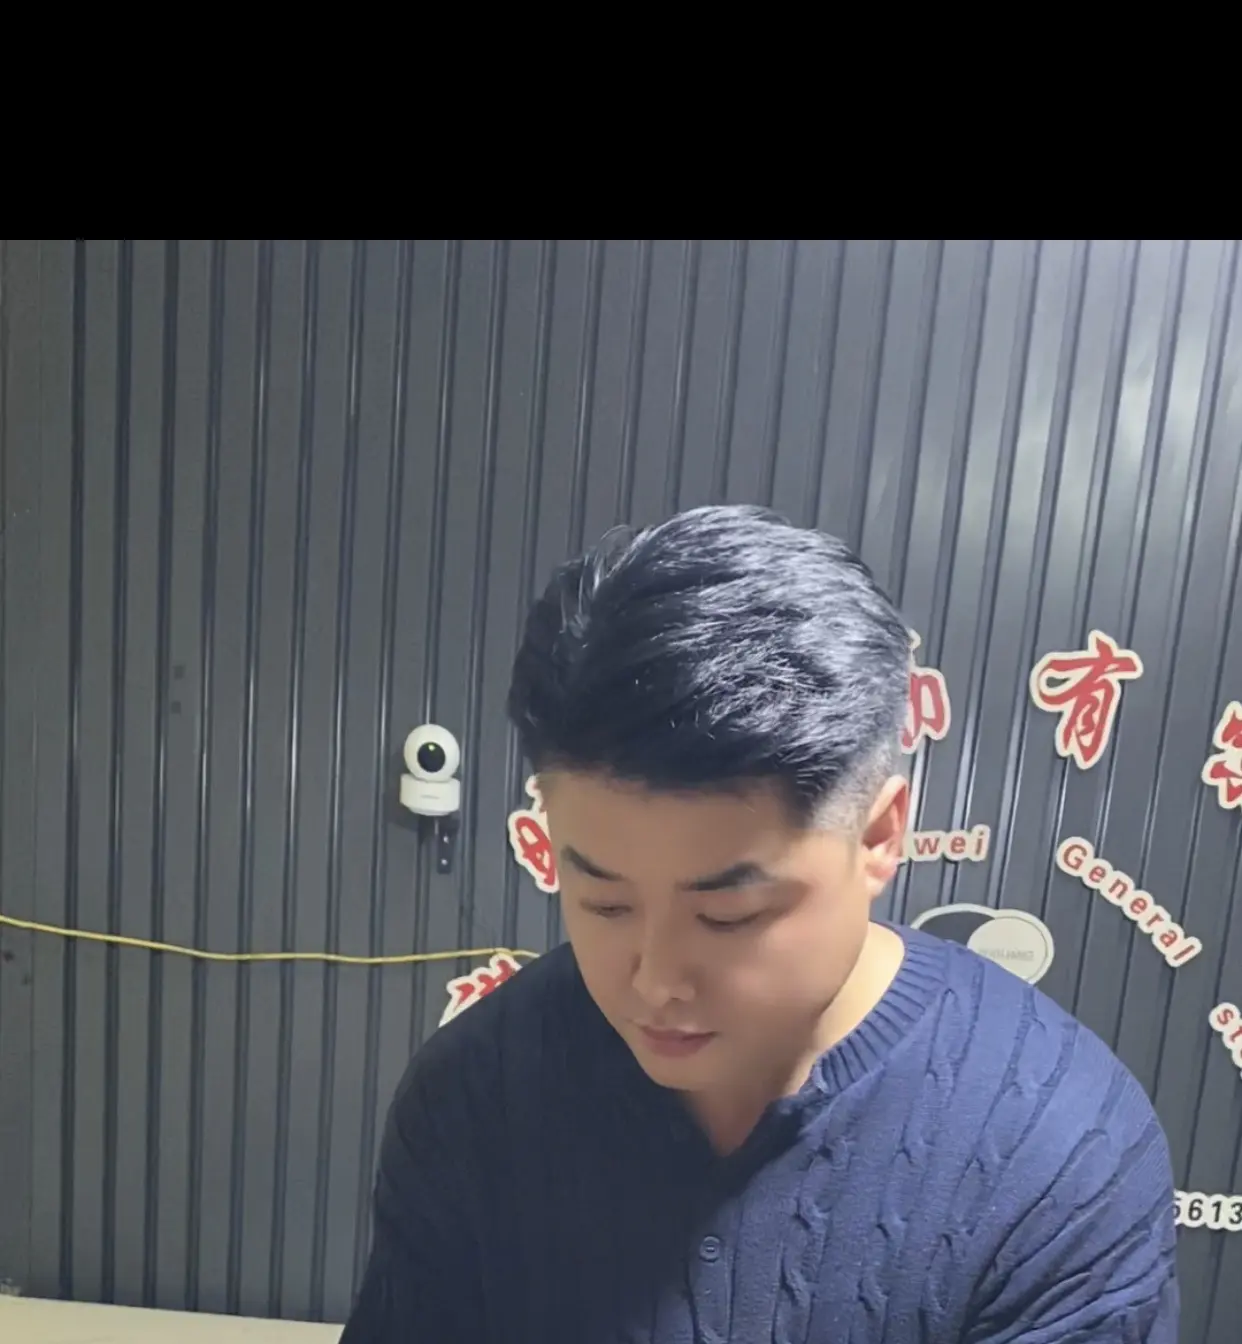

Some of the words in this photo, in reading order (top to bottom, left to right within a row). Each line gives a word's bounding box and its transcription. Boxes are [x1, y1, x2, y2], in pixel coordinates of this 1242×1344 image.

[1037, 636, 1139, 763] 有
[912, 830, 985, 857] wei
[1062, 843, 1196, 961] General
[1217, 1008, 1242, 1060] st
